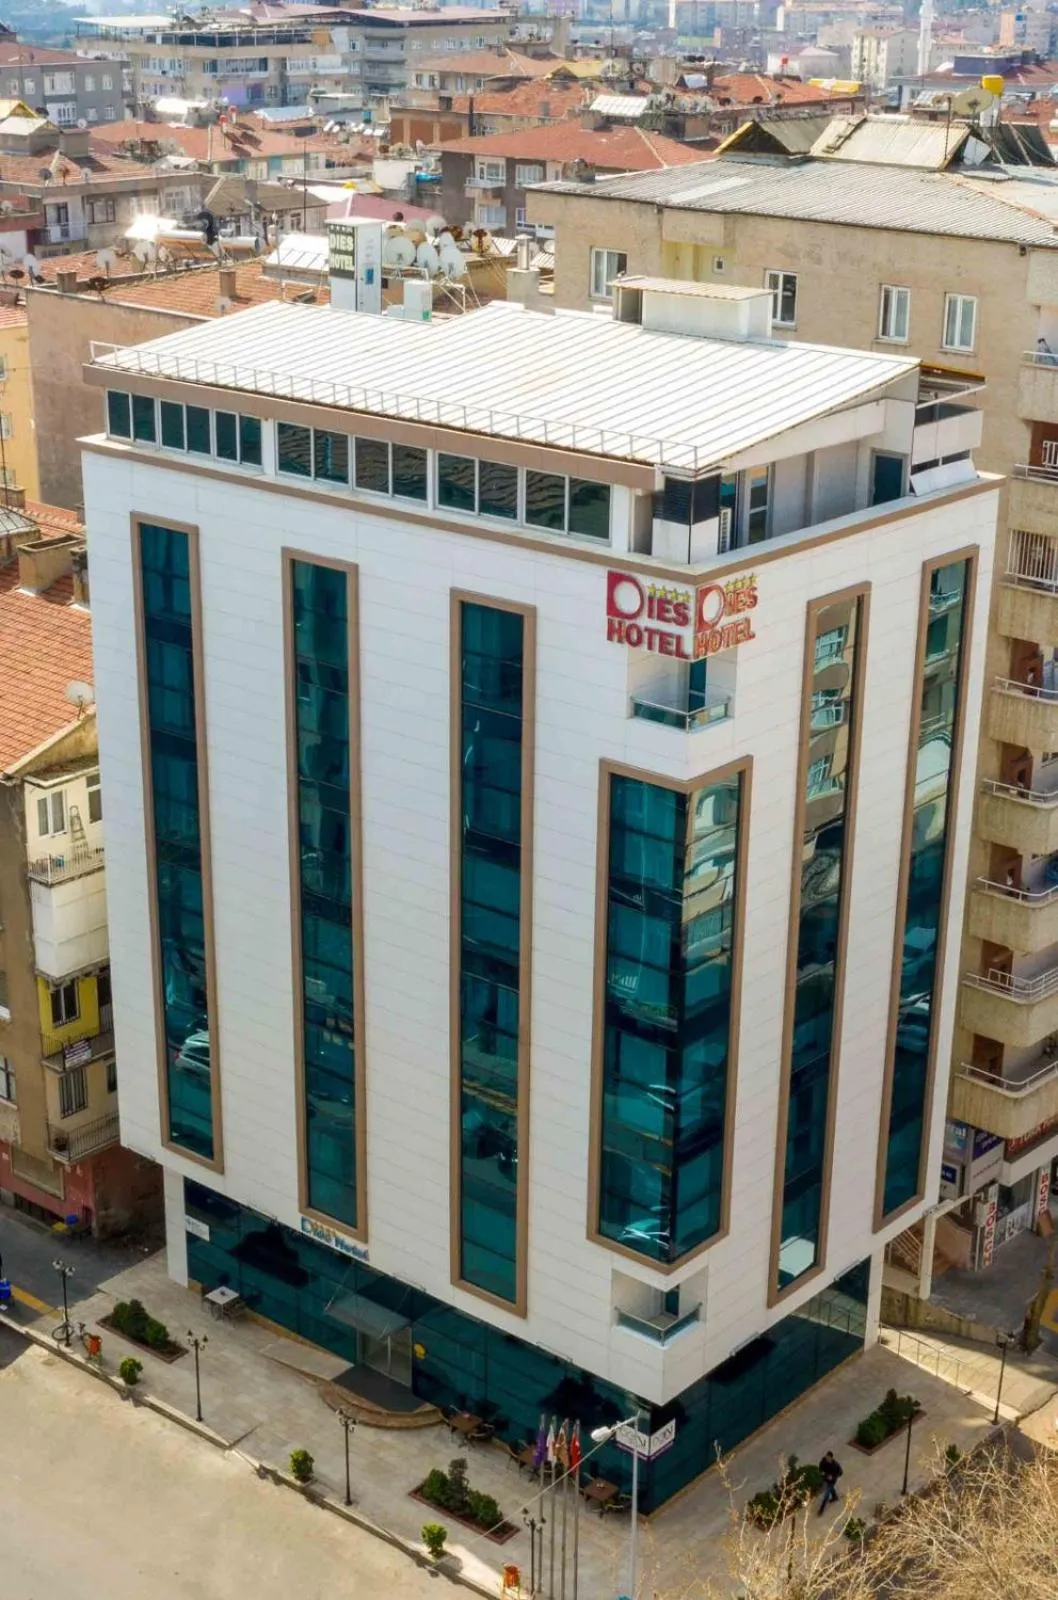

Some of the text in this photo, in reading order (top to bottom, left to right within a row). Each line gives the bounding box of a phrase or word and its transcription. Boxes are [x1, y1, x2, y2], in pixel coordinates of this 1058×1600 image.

[329, 233, 354, 251] DIES
[329, 253, 354, 271] HOTEL
[607, 570, 689, 627] DIES
[696, 584, 758, 632] DIES
[607, 617, 691, 660] HOTEL
[695, 617, 756, 659] HOTEL
